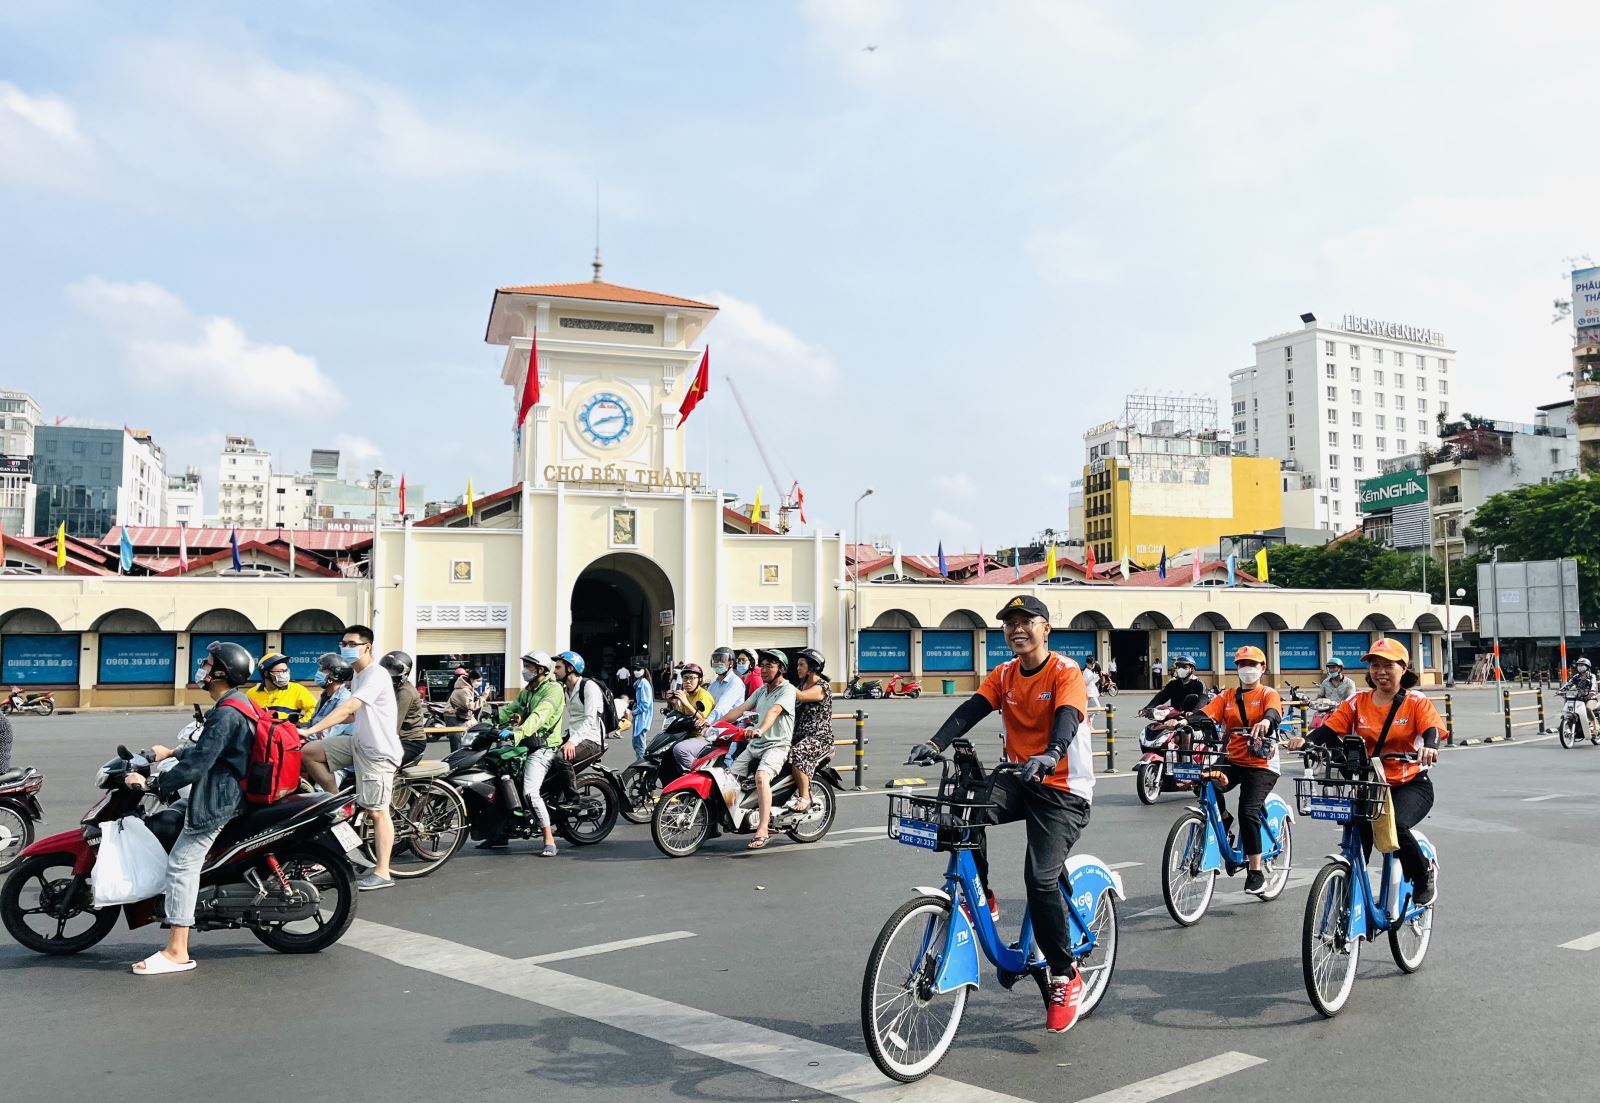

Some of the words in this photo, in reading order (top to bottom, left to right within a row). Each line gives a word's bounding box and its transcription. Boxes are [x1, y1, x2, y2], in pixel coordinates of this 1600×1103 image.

[1344, 313, 1386, 336] LIBERTY
[543, 464, 584, 482] CHỢ
[591, 463, 628, 485] BẾN
[635, 467, 702, 487] THÀNH
